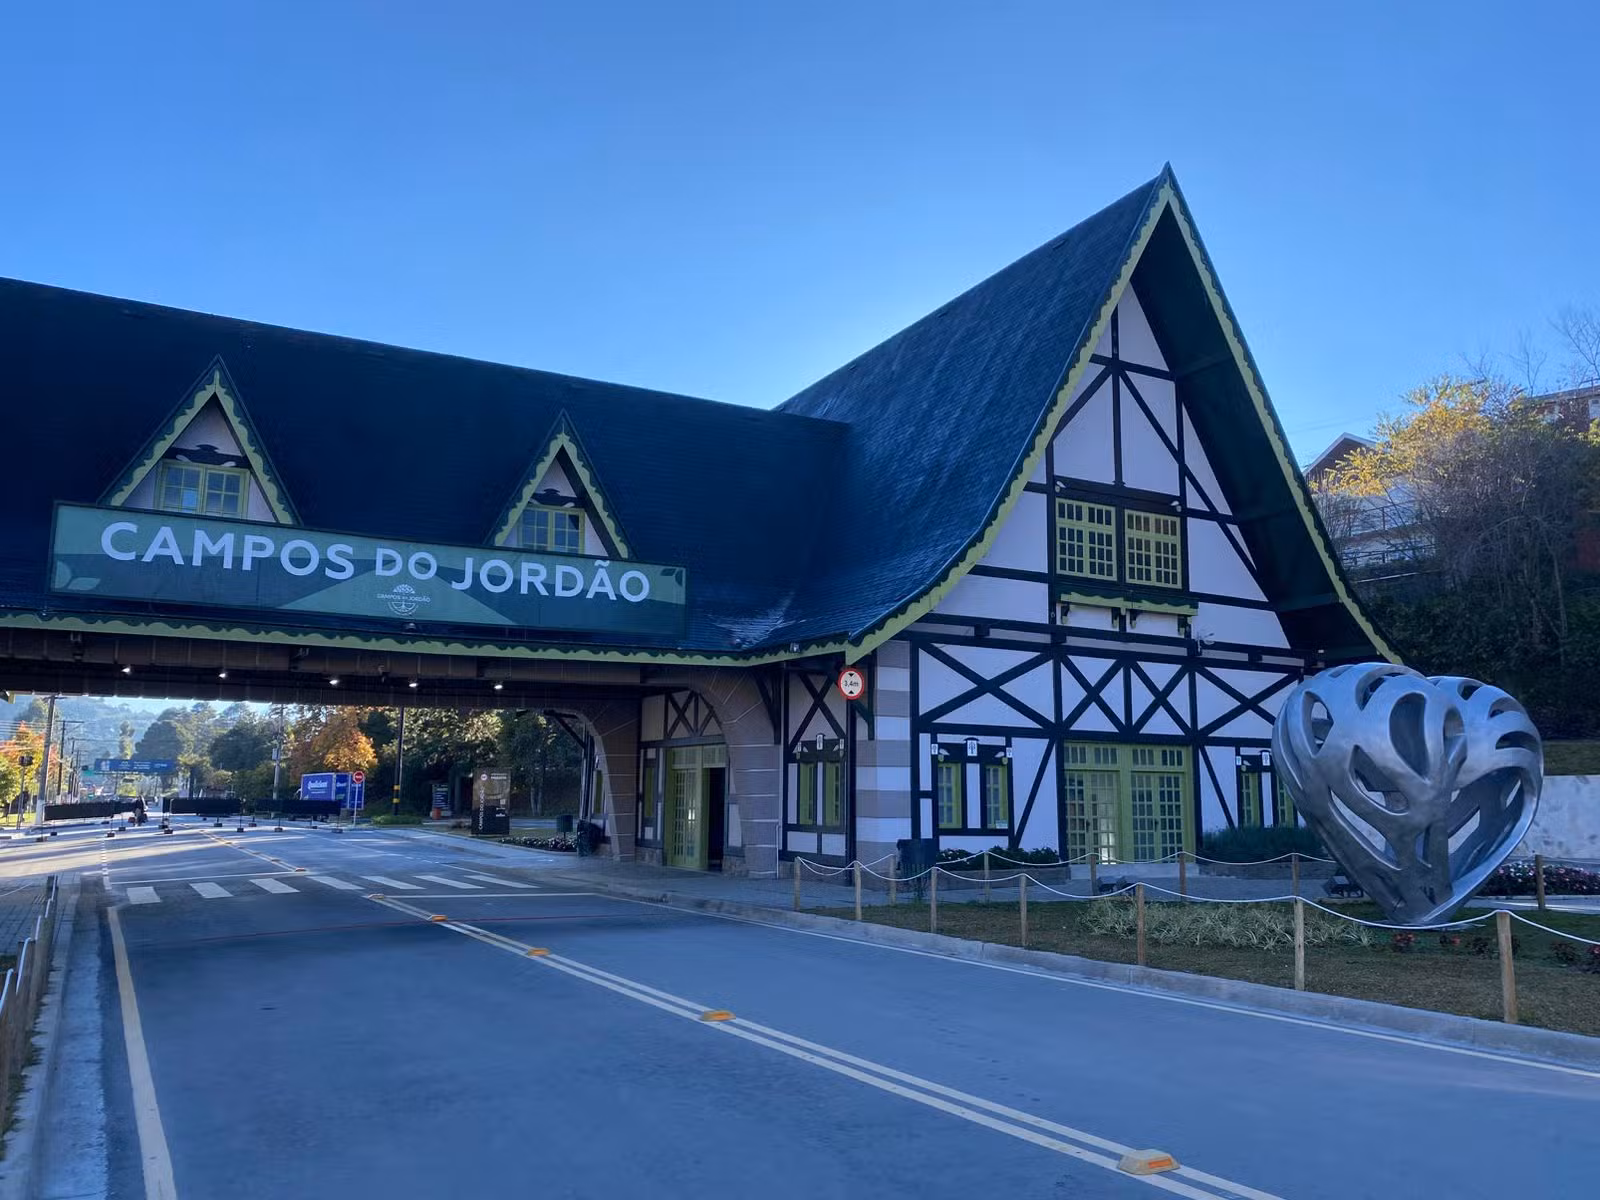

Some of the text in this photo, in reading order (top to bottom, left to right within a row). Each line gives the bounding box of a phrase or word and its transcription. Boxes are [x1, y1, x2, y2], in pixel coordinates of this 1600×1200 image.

[101, 521, 650, 603] CAMPOS DO JORDÃO
